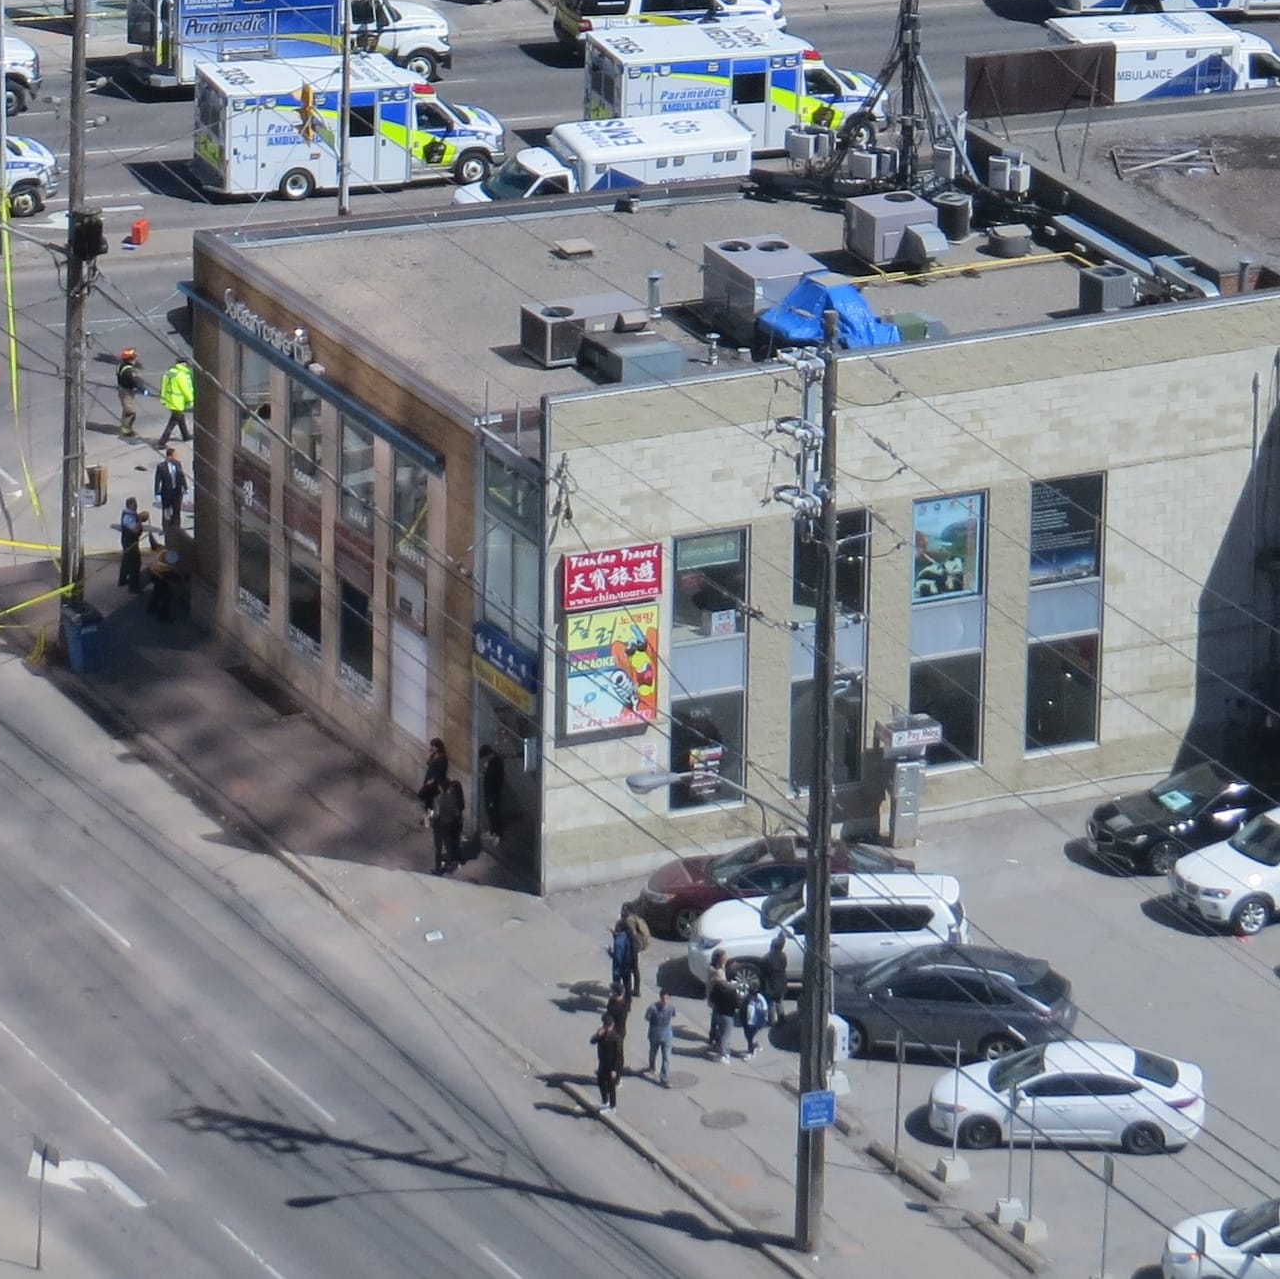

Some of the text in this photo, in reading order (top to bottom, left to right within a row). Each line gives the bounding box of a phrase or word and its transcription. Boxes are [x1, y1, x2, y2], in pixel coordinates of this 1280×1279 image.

[185, 13, 266, 35] Paramedic
[701, 27, 743, 49] MEDICS
[732, 26, 771, 49] YORK
[1117, 69, 1173, 82] MBULANCE
[660, 87, 727, 101] Paramedics
[661, 101, 720, 113] AMBULANCE
[596, 120, 646, 147] EMS
[621, 548, 659, 563] Travel
[569, 560, 657, 595] 天寶旅遊
[569, 586, 660, 606] www.chinatours.ca
[570, 657, 616, 673] KARAOKE
